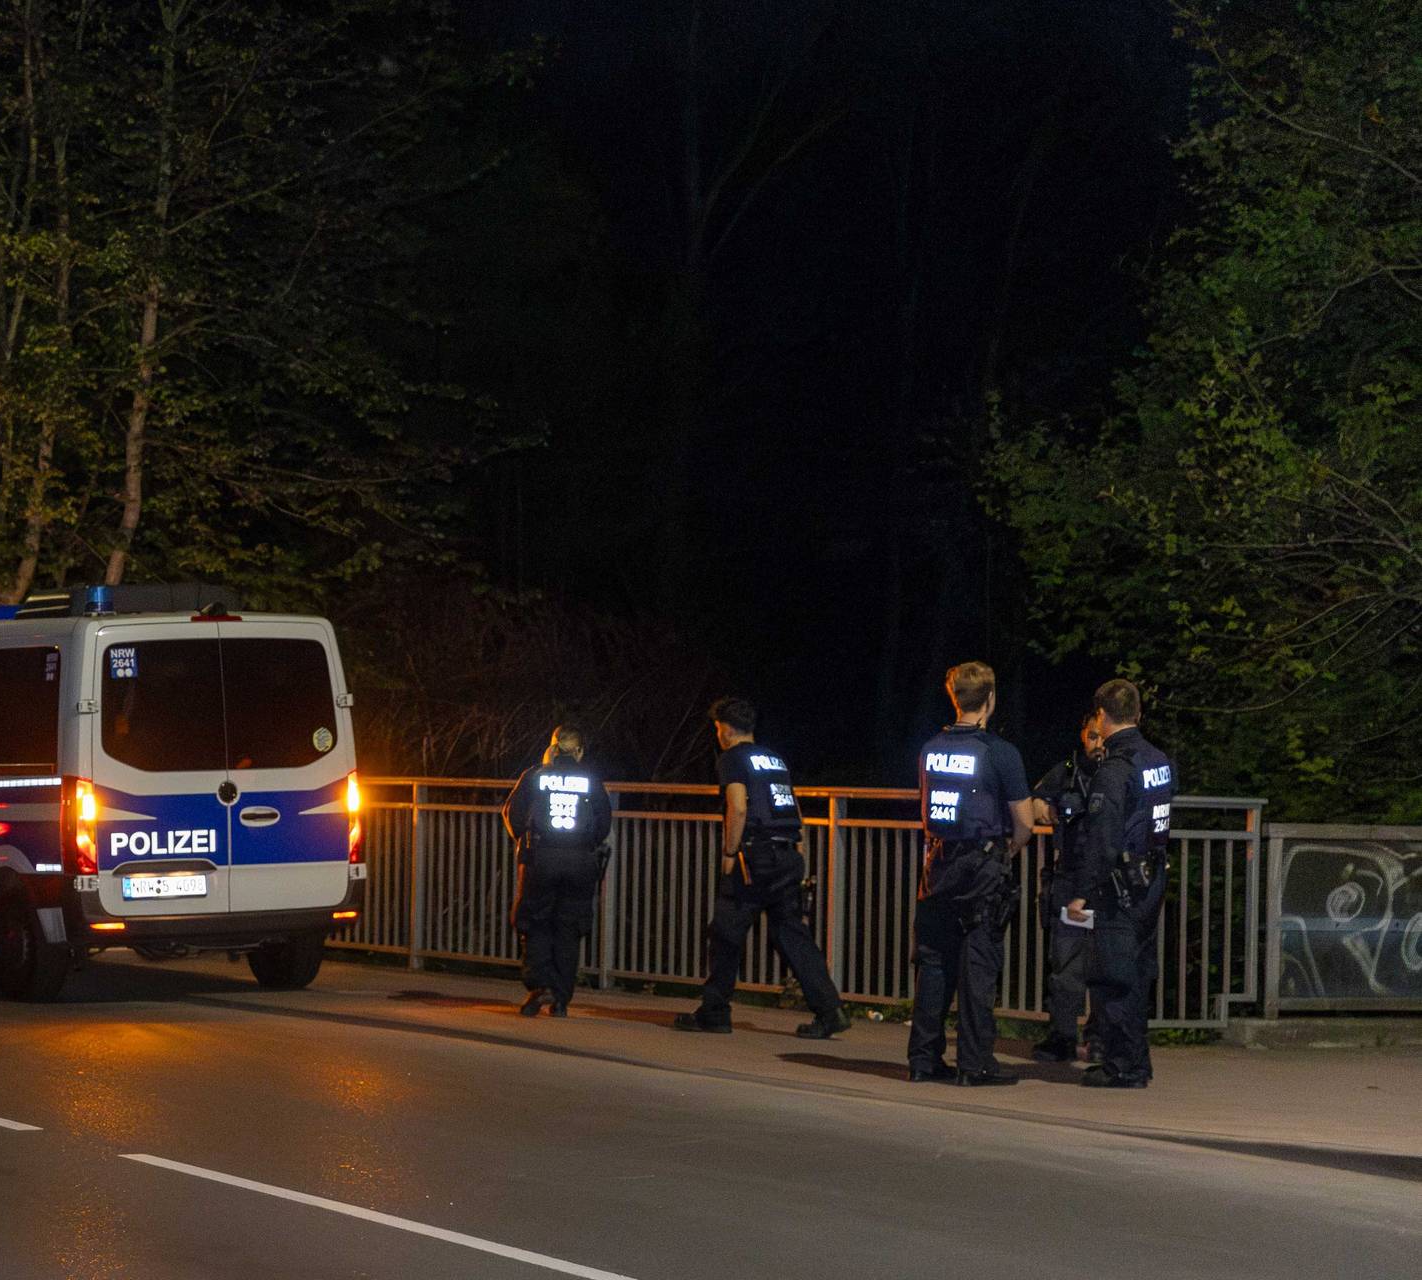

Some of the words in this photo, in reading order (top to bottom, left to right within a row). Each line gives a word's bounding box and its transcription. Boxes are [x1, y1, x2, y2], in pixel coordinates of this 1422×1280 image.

[110, 648, 135, 658] NRW
[112, 658, 135, 668] 2641
[926, 752, 975, 775] POLIZEI
[930, 805, 956, 821] 2641
[110, 829, 216, 856] POLIZEI
